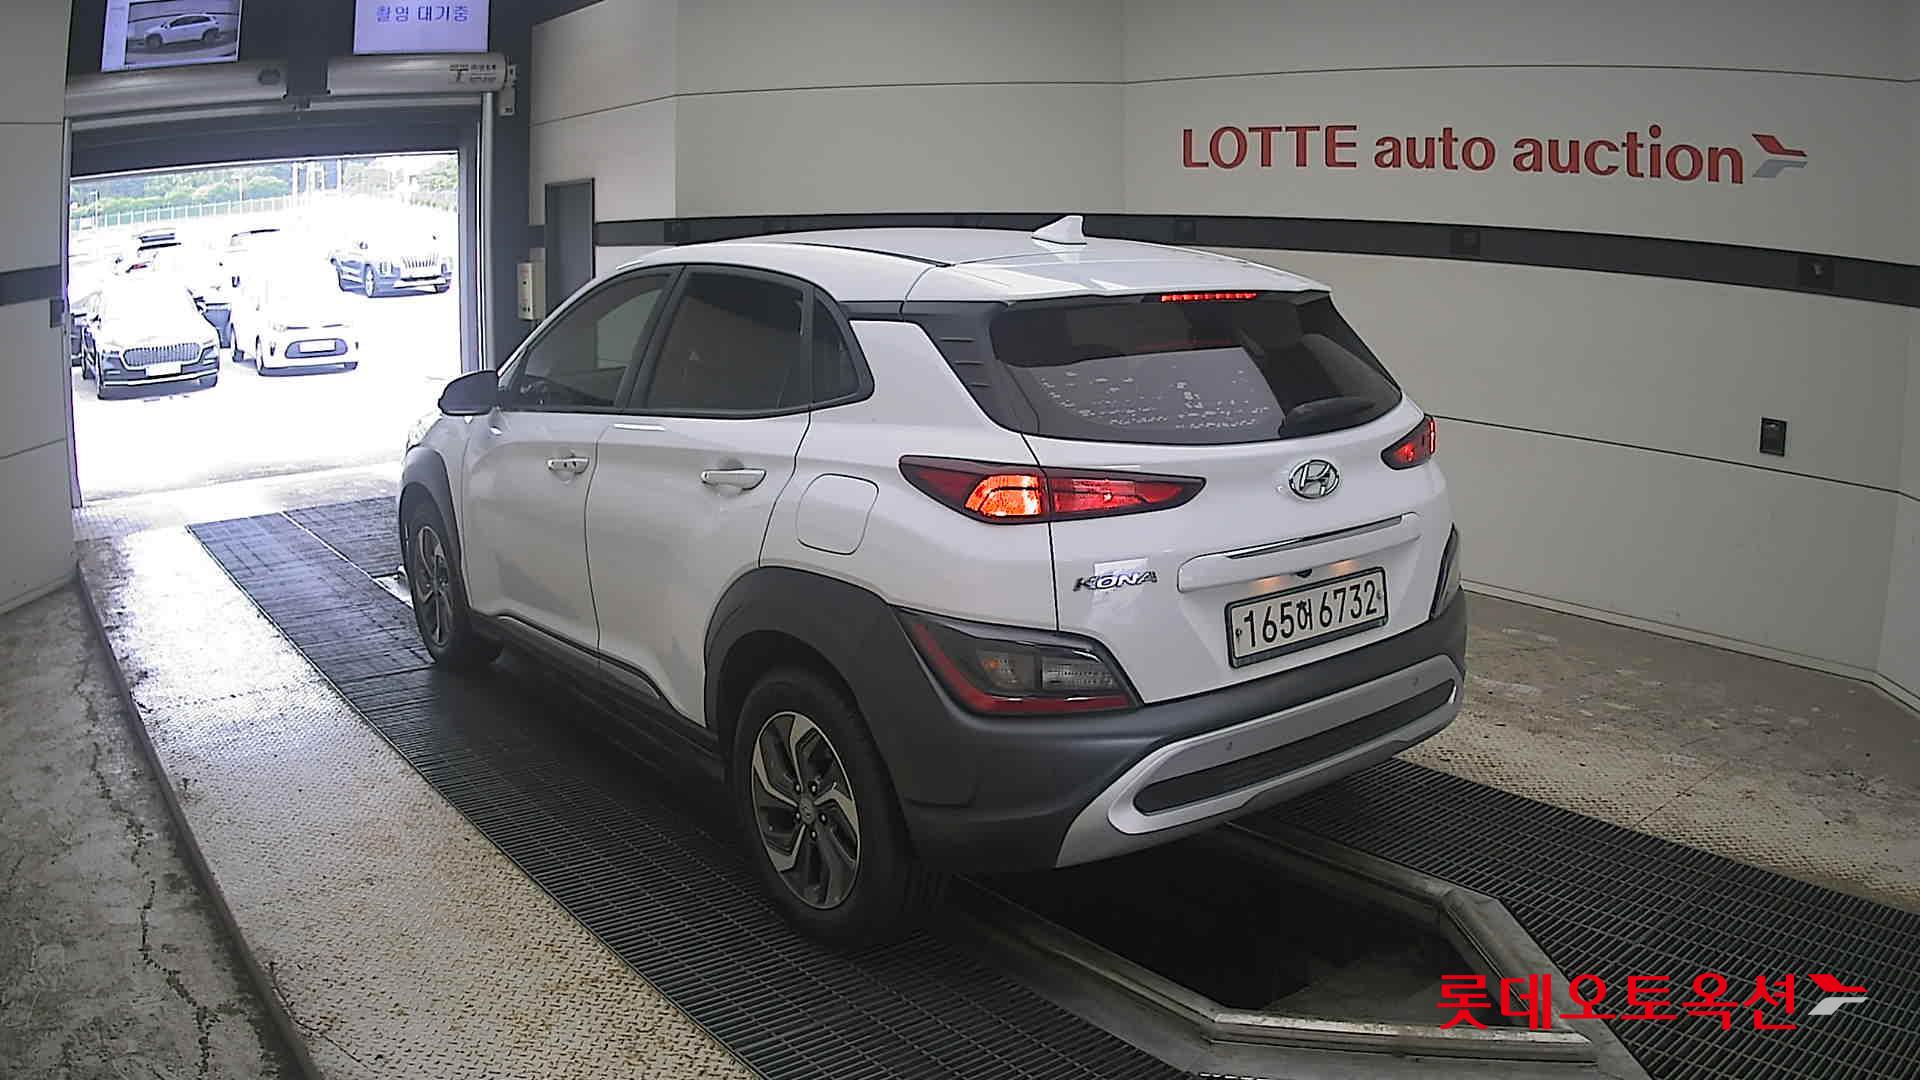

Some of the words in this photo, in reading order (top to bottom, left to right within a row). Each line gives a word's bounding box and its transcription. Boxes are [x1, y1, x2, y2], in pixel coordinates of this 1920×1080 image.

[417, 5, 469, 22] 대기중
[1182, 124, 1358, 169] LOTTE
[1374, 127, 1496, 171] auto
[1513, 124, 1744, 184] auction
[1072, 570, 1158, 592] KONA
